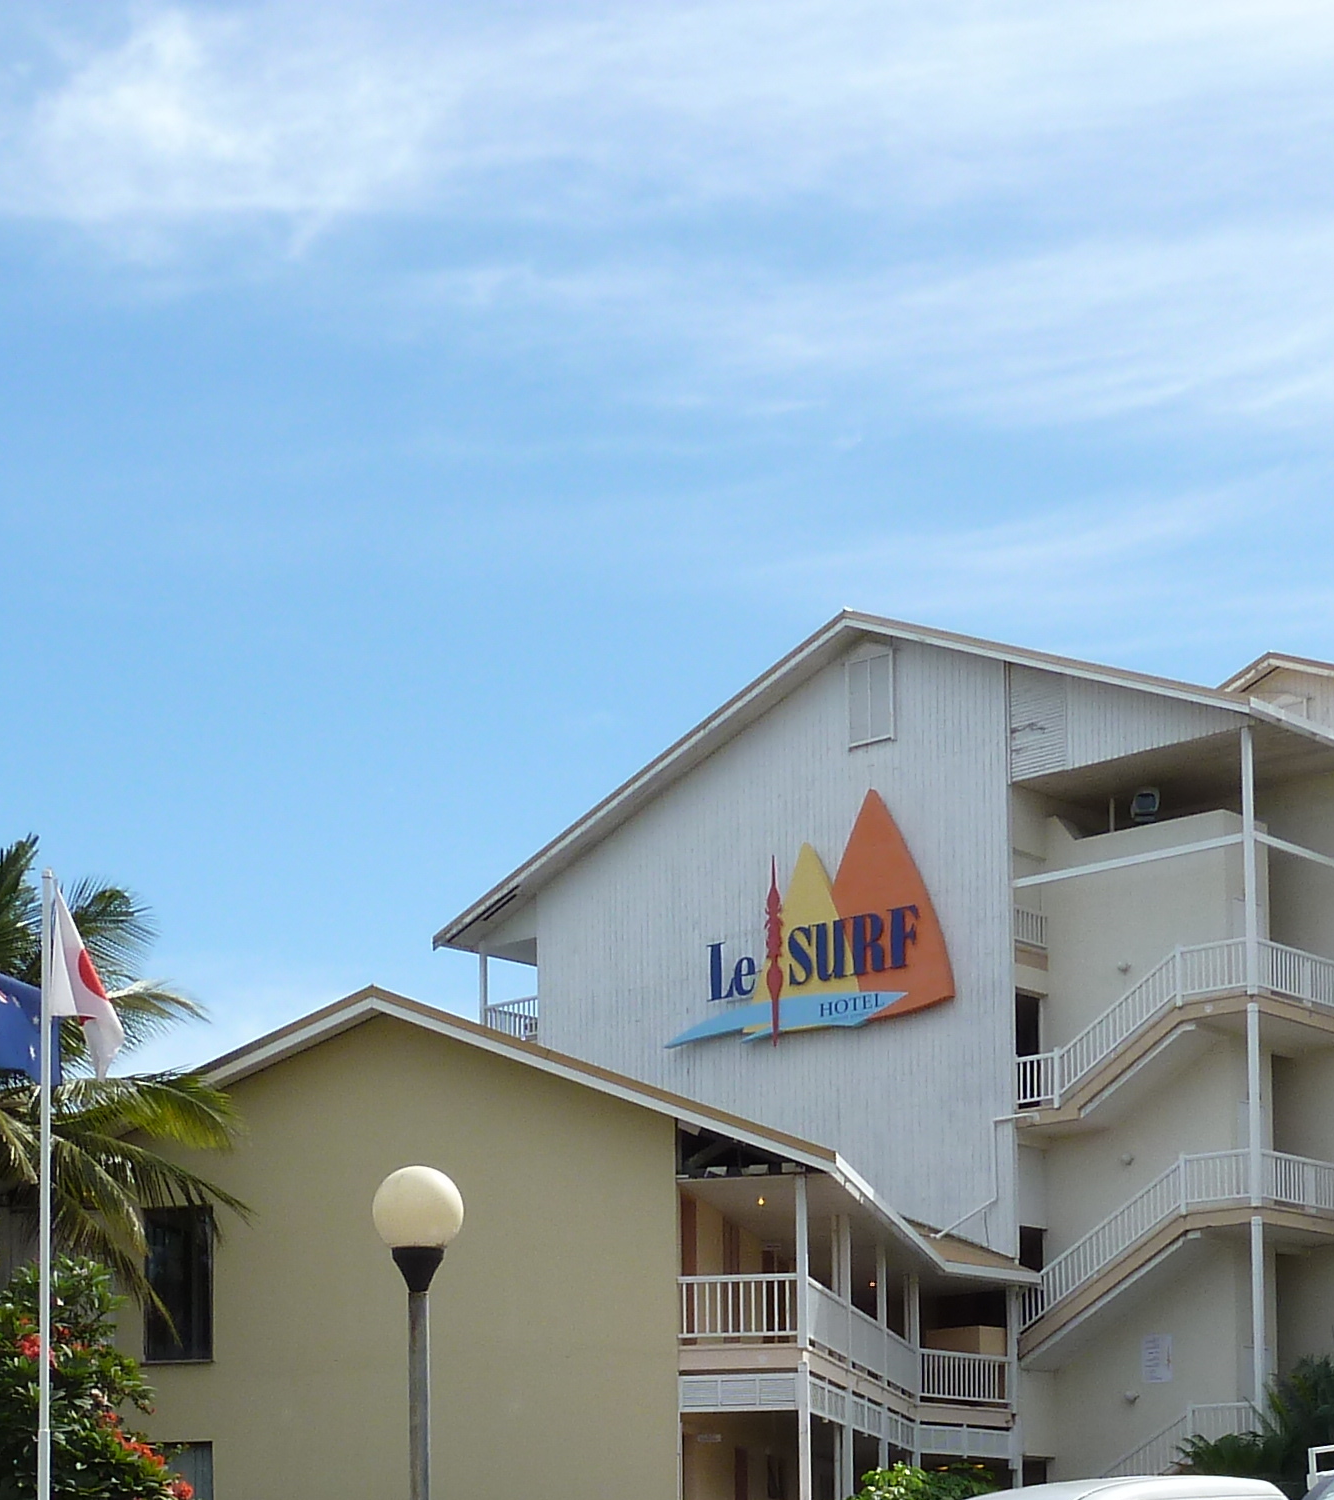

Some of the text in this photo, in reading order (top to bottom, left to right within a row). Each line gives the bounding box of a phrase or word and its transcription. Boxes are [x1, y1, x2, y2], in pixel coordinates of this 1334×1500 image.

[707, 904, 921, 1002] Le SURF
[820, 993, 885, 1017] HOTEL
